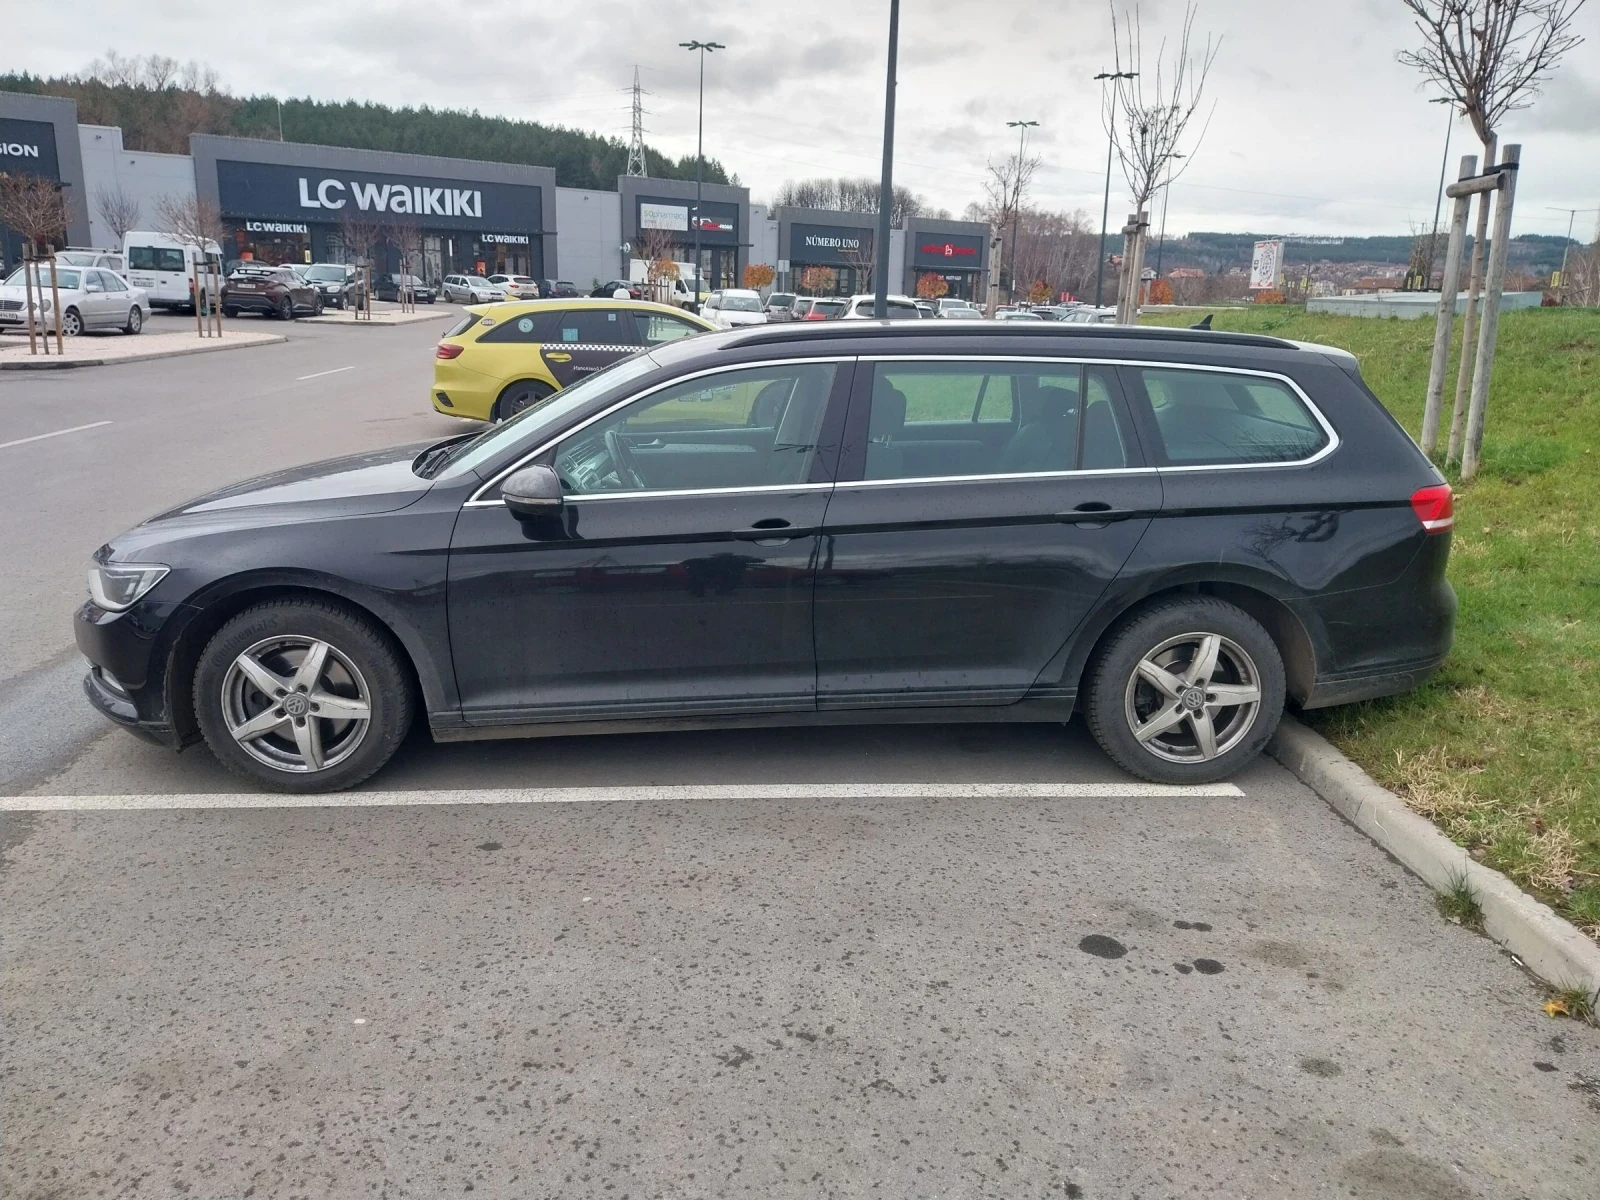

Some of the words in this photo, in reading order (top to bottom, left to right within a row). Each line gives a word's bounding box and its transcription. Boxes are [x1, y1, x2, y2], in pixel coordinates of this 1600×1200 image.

[299, 178, 346, 210] LC
[246, 222, 262, 232] LC
[482, 233, 494, 242] LC
[805, 234, 841, 248] NÚMERO
[842, 238, 860, 249] UNO
